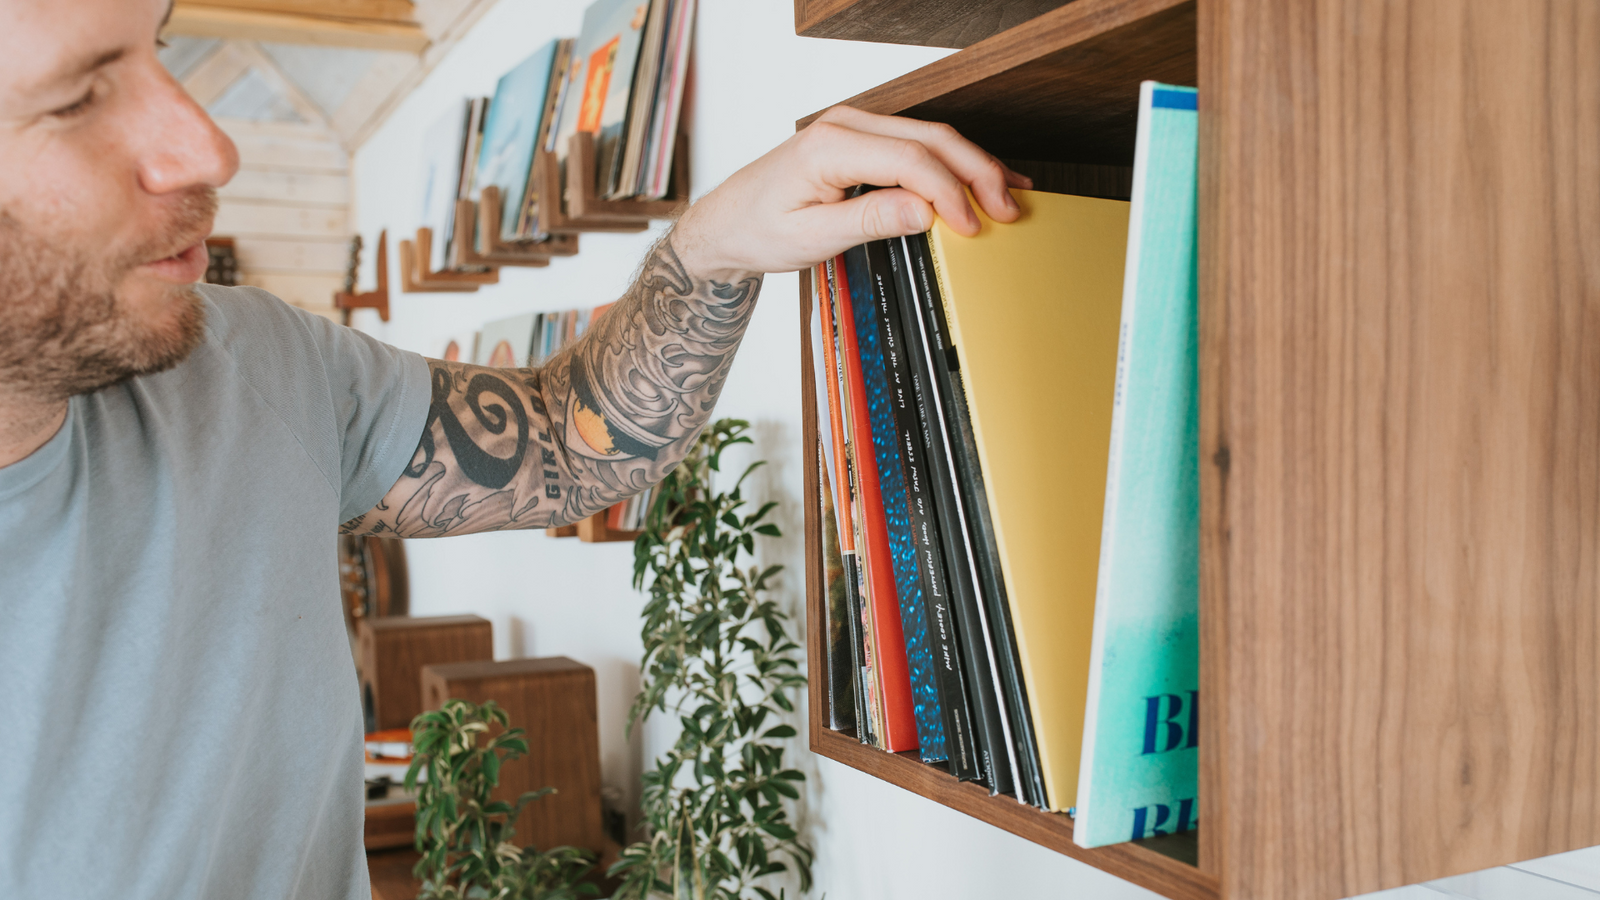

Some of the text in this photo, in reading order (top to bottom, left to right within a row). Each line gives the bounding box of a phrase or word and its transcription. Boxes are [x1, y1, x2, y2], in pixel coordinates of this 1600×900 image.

[876, 274, 887, 314] THEATRE
[894, 372, 900, 384] AT
[897, 388, 905, 408] LIVE
[911, 466, 920, 492] JASON
